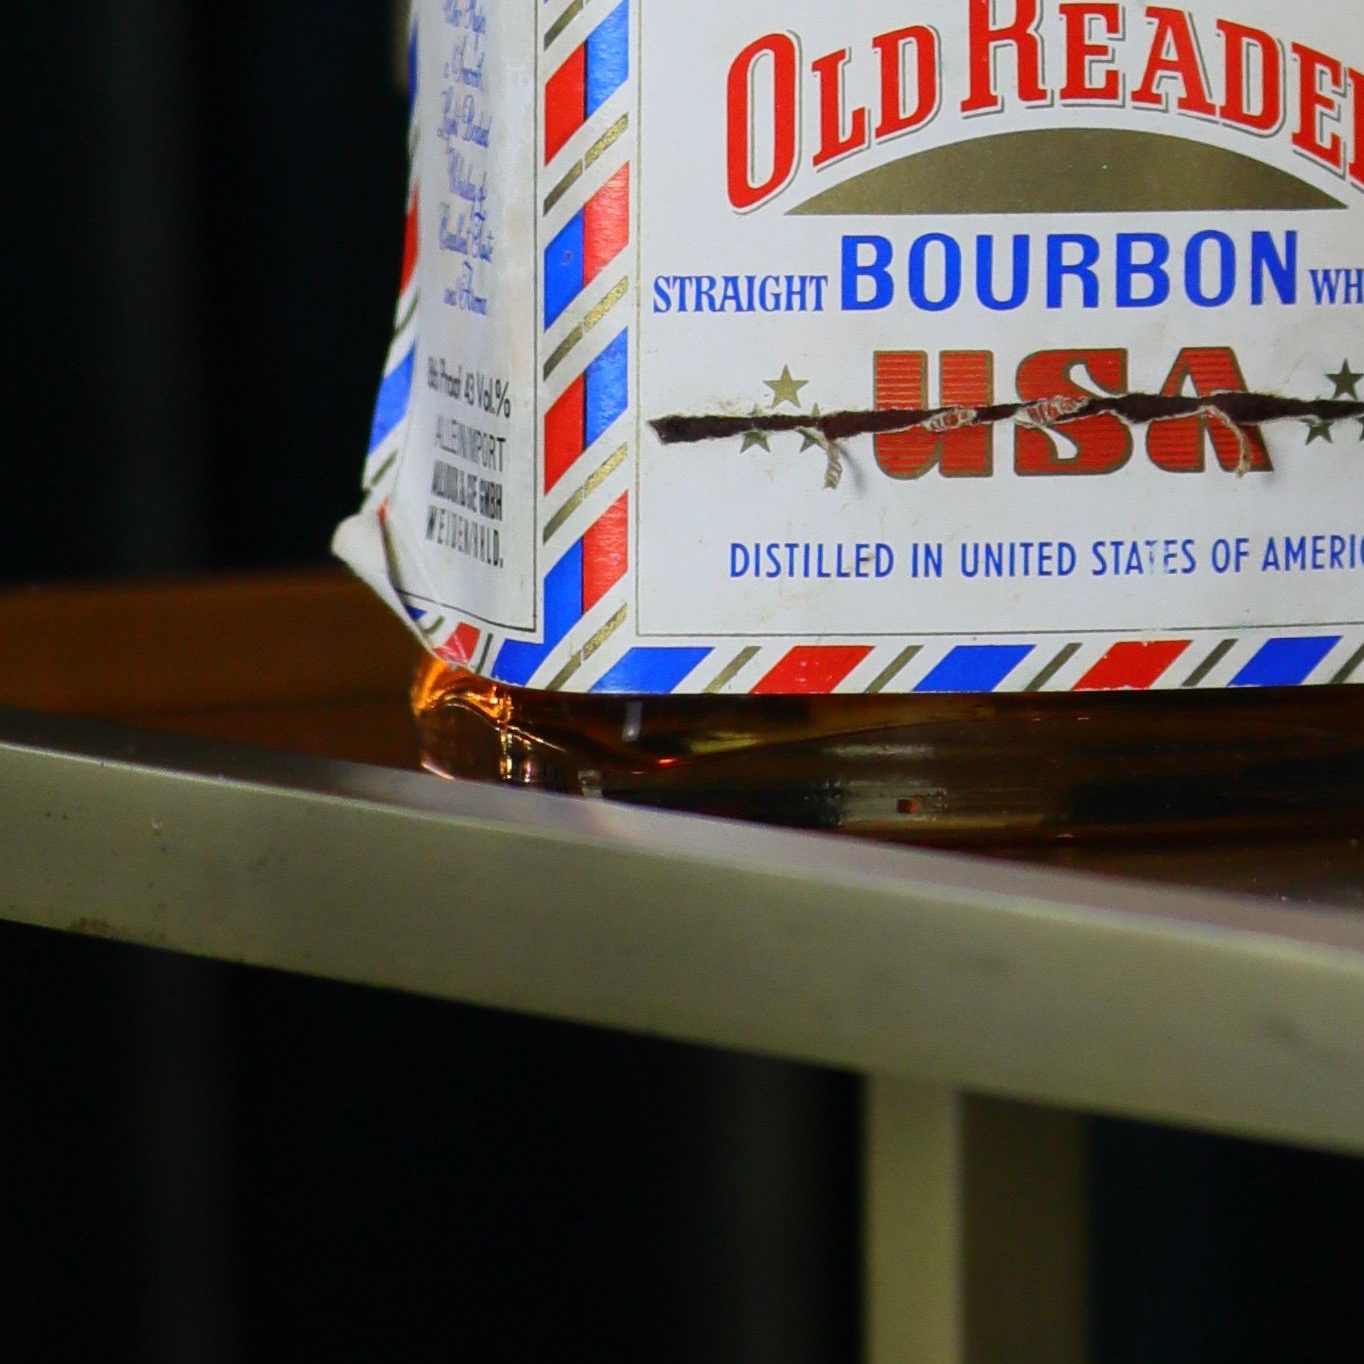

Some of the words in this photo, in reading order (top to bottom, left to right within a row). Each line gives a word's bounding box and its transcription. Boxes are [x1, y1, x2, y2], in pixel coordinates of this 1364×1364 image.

[724, 23, 939, 217] OLD
[652, 272, 828, 314] STRAIGHT
[840, 228, 1298, 313] BOURBON
[872, 346, 1274, 482] USA
[729, 542, 894, 580] DISTILLED
[910, 541, 943, 579] IN
[960, 540, 1077, 578] UNITED
[1092, 539, 1197, 577] STATES
[1211, 537, 1250, 574] OF
